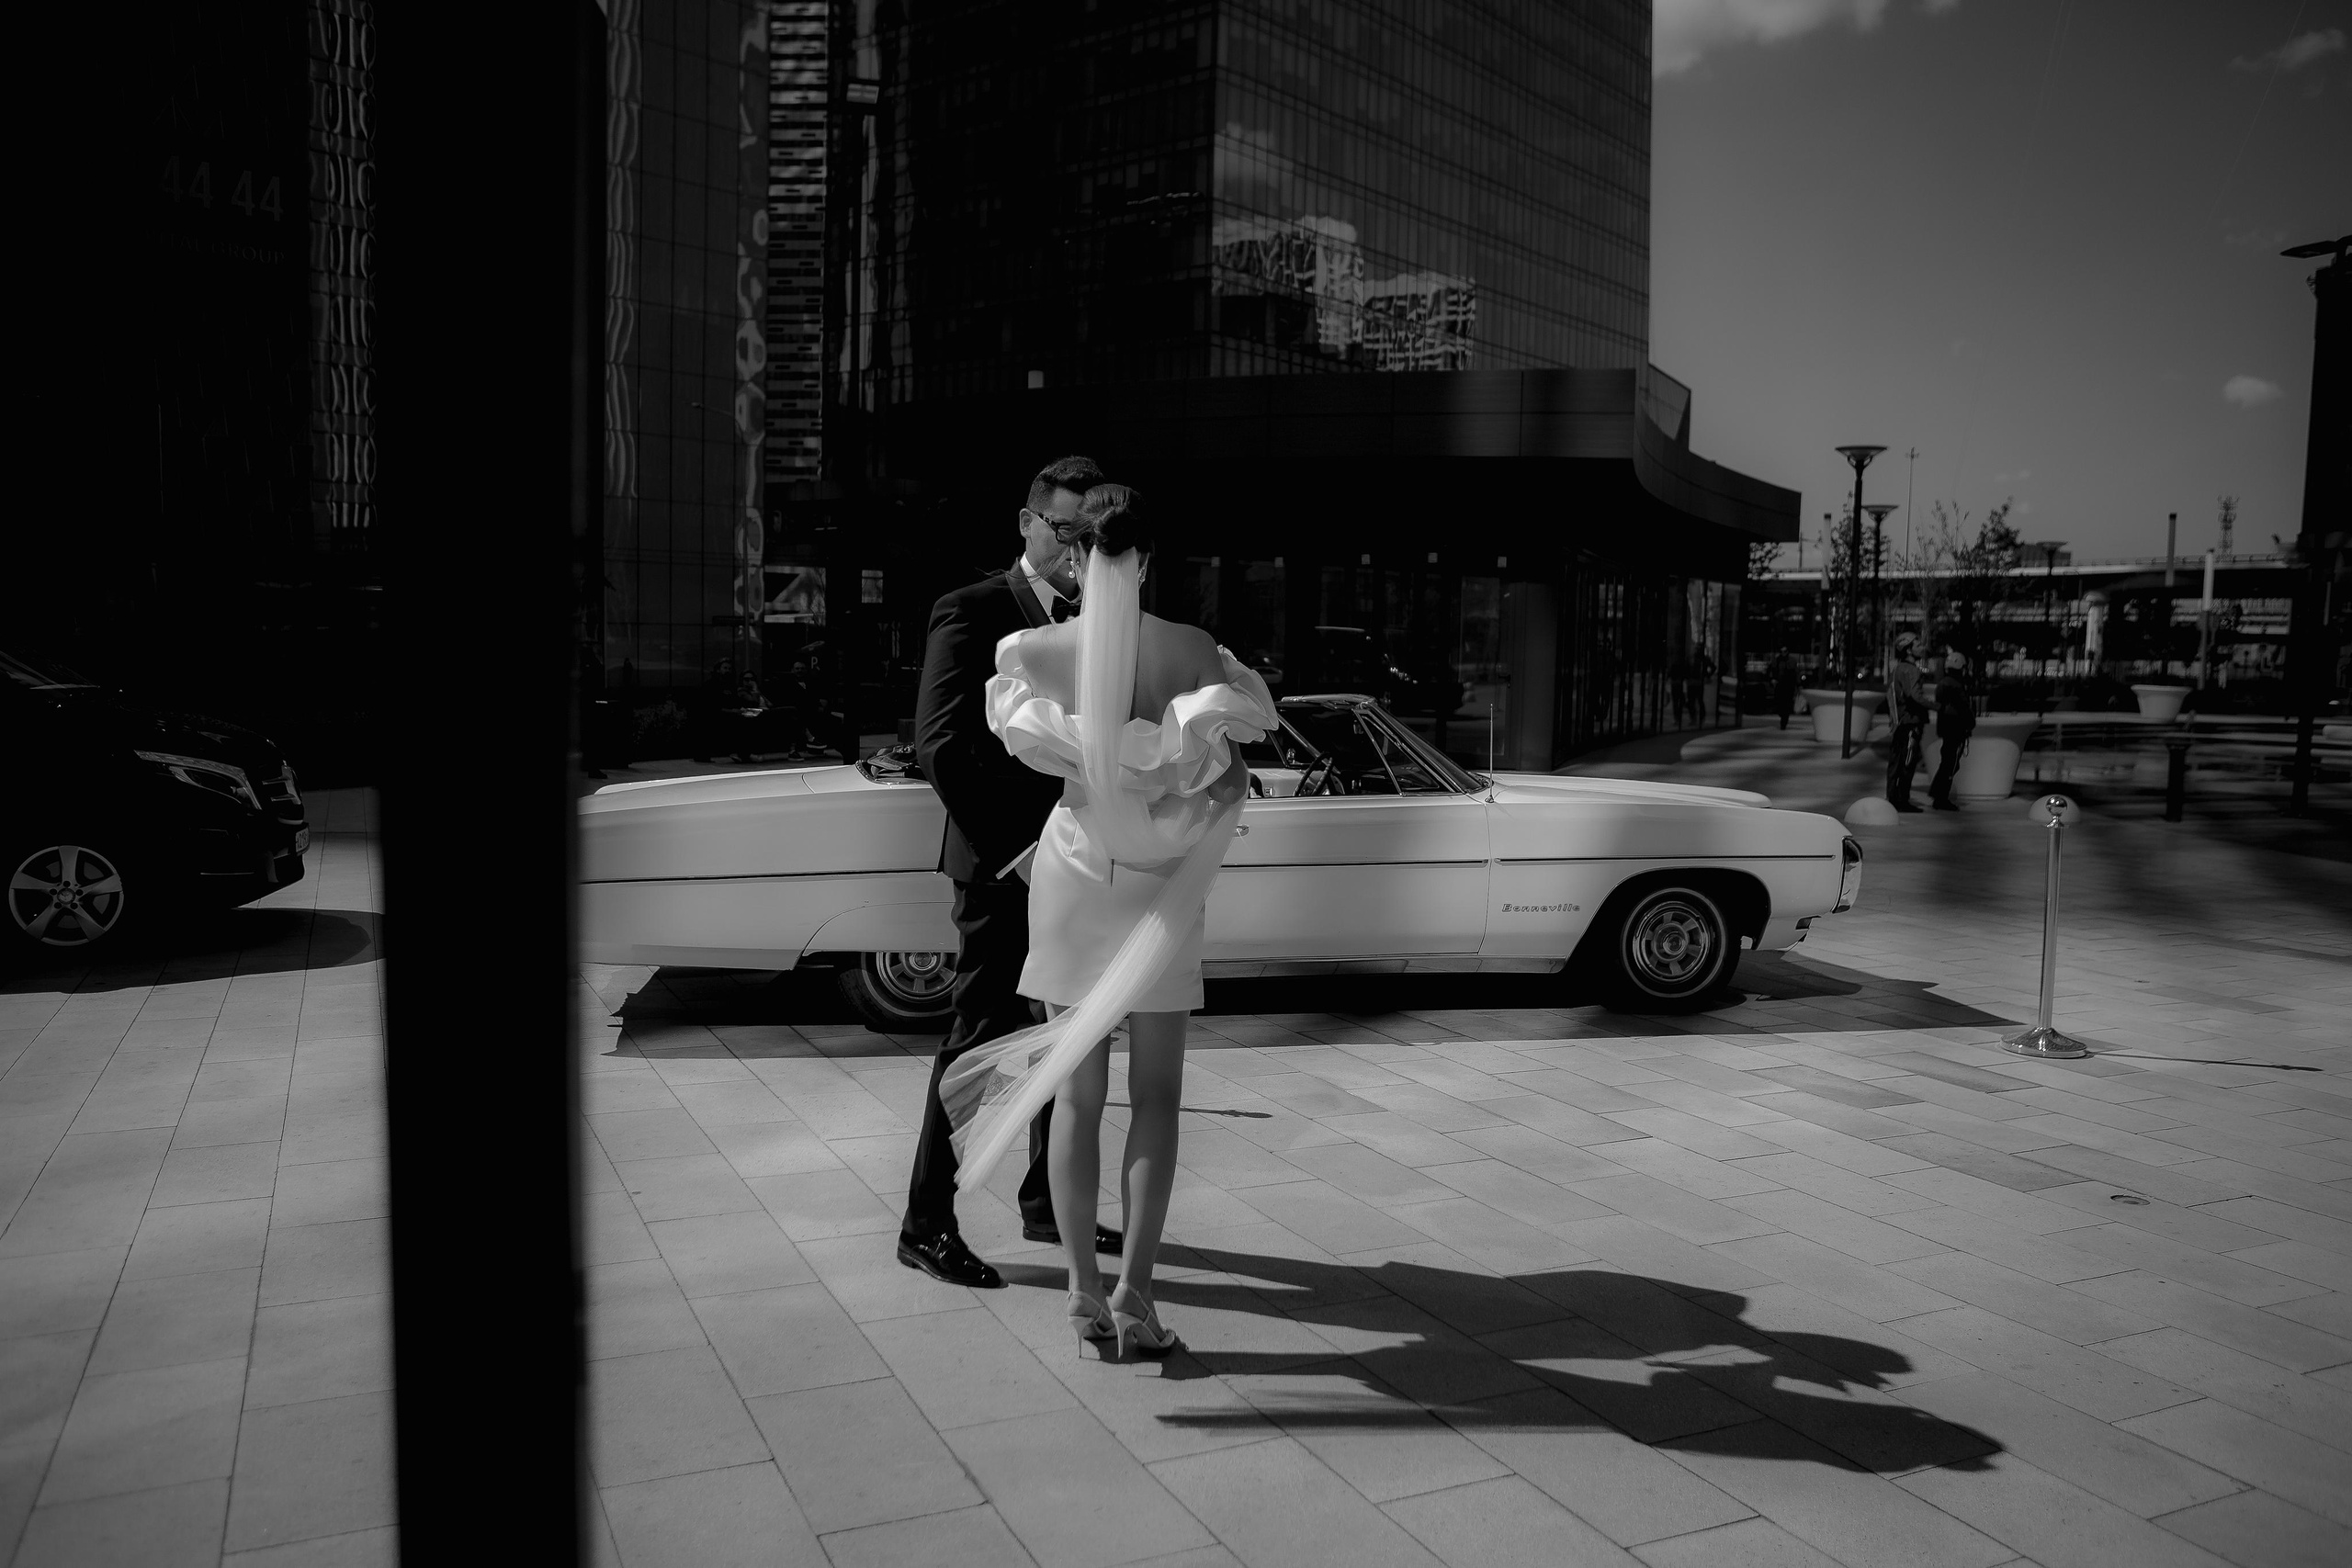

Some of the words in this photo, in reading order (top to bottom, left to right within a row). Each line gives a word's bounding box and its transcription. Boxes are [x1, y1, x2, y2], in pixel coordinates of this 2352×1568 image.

[159, 154, 214, 209] 44
[231, 169, 284, 222] 44
[211, 242, 286, 265] GROUP
[1501, 903, 1580, 912] Bonneville
